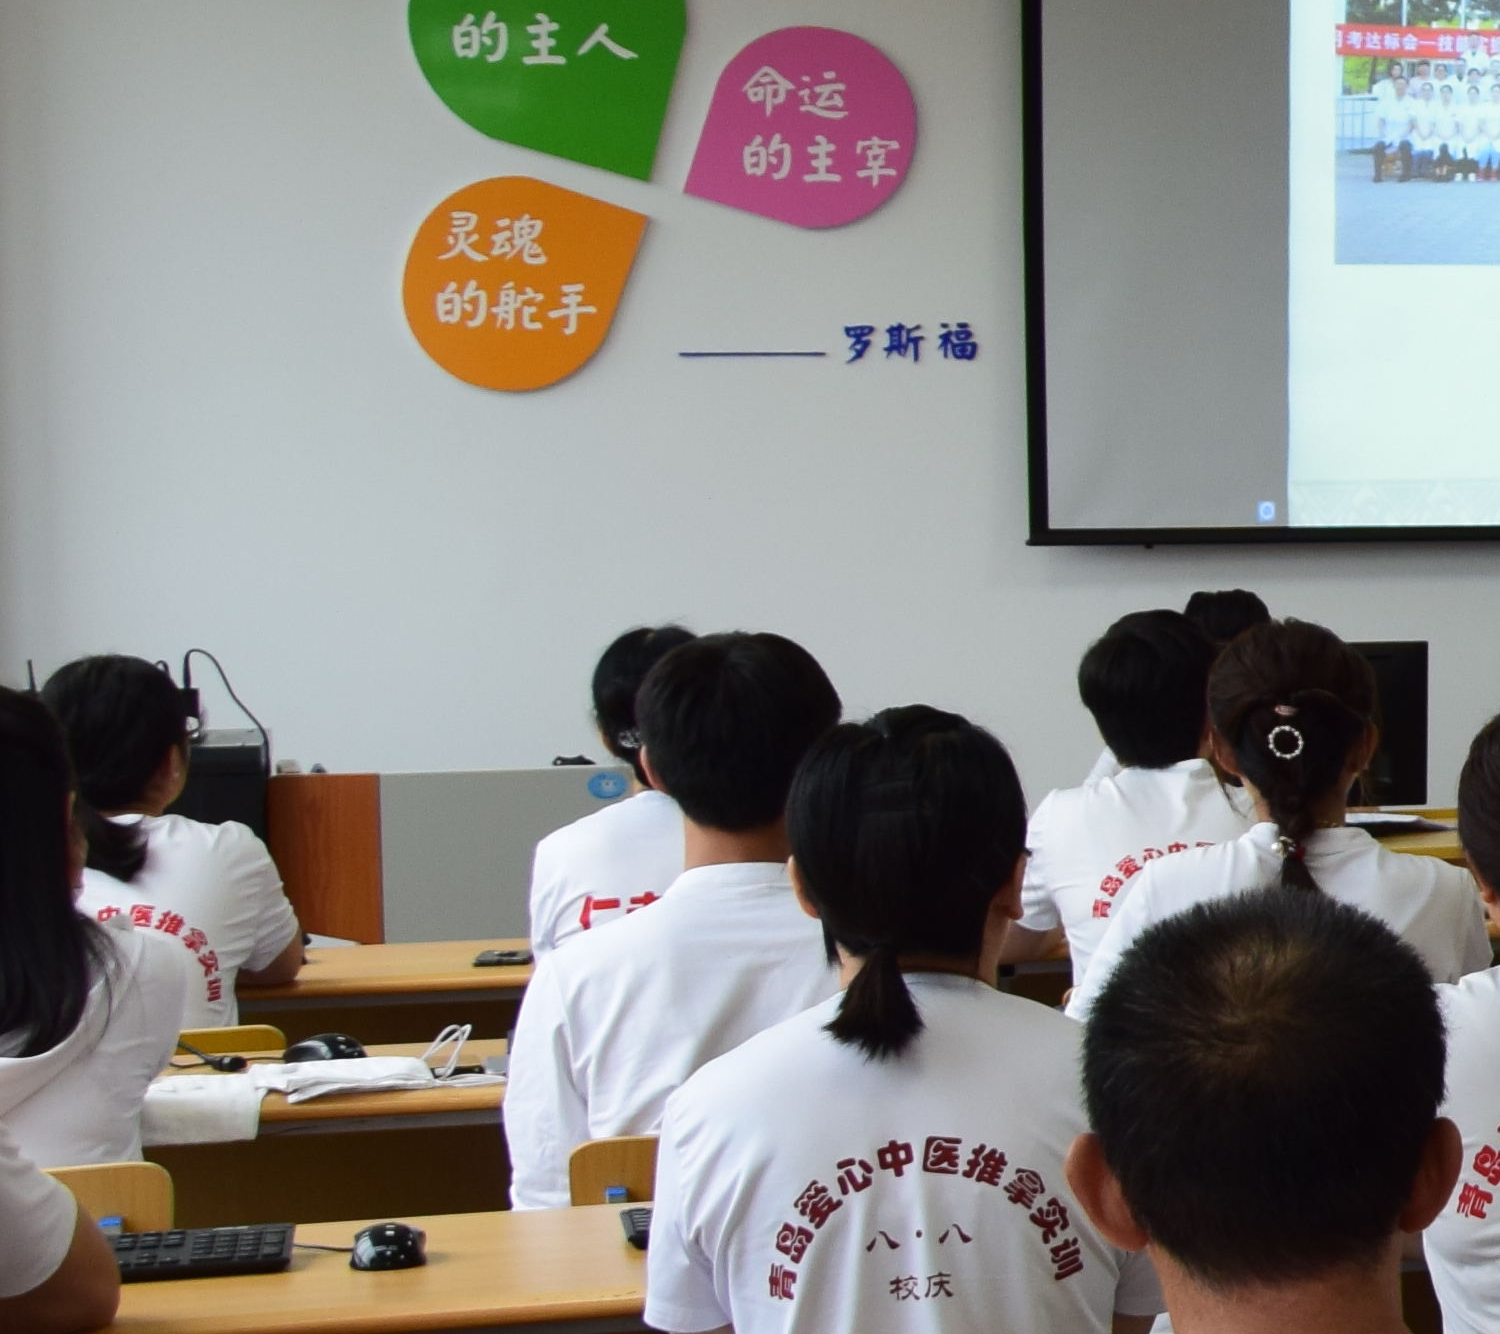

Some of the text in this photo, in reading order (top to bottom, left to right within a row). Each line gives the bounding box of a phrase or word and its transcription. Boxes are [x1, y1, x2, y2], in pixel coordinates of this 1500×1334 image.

[452, 11, 638, 65] 的主人
[742, 65, 849, 118] 命运
[742, 133, 900, 187] 的主宰
[437, 210, 547, 265] 灵魂
[435, 280, 598, 335] 的舵手
[768, 1136, 1085, 1301] 青岛爱心中医推拿实训
[889, 1272, 954, 1302] 校庆
